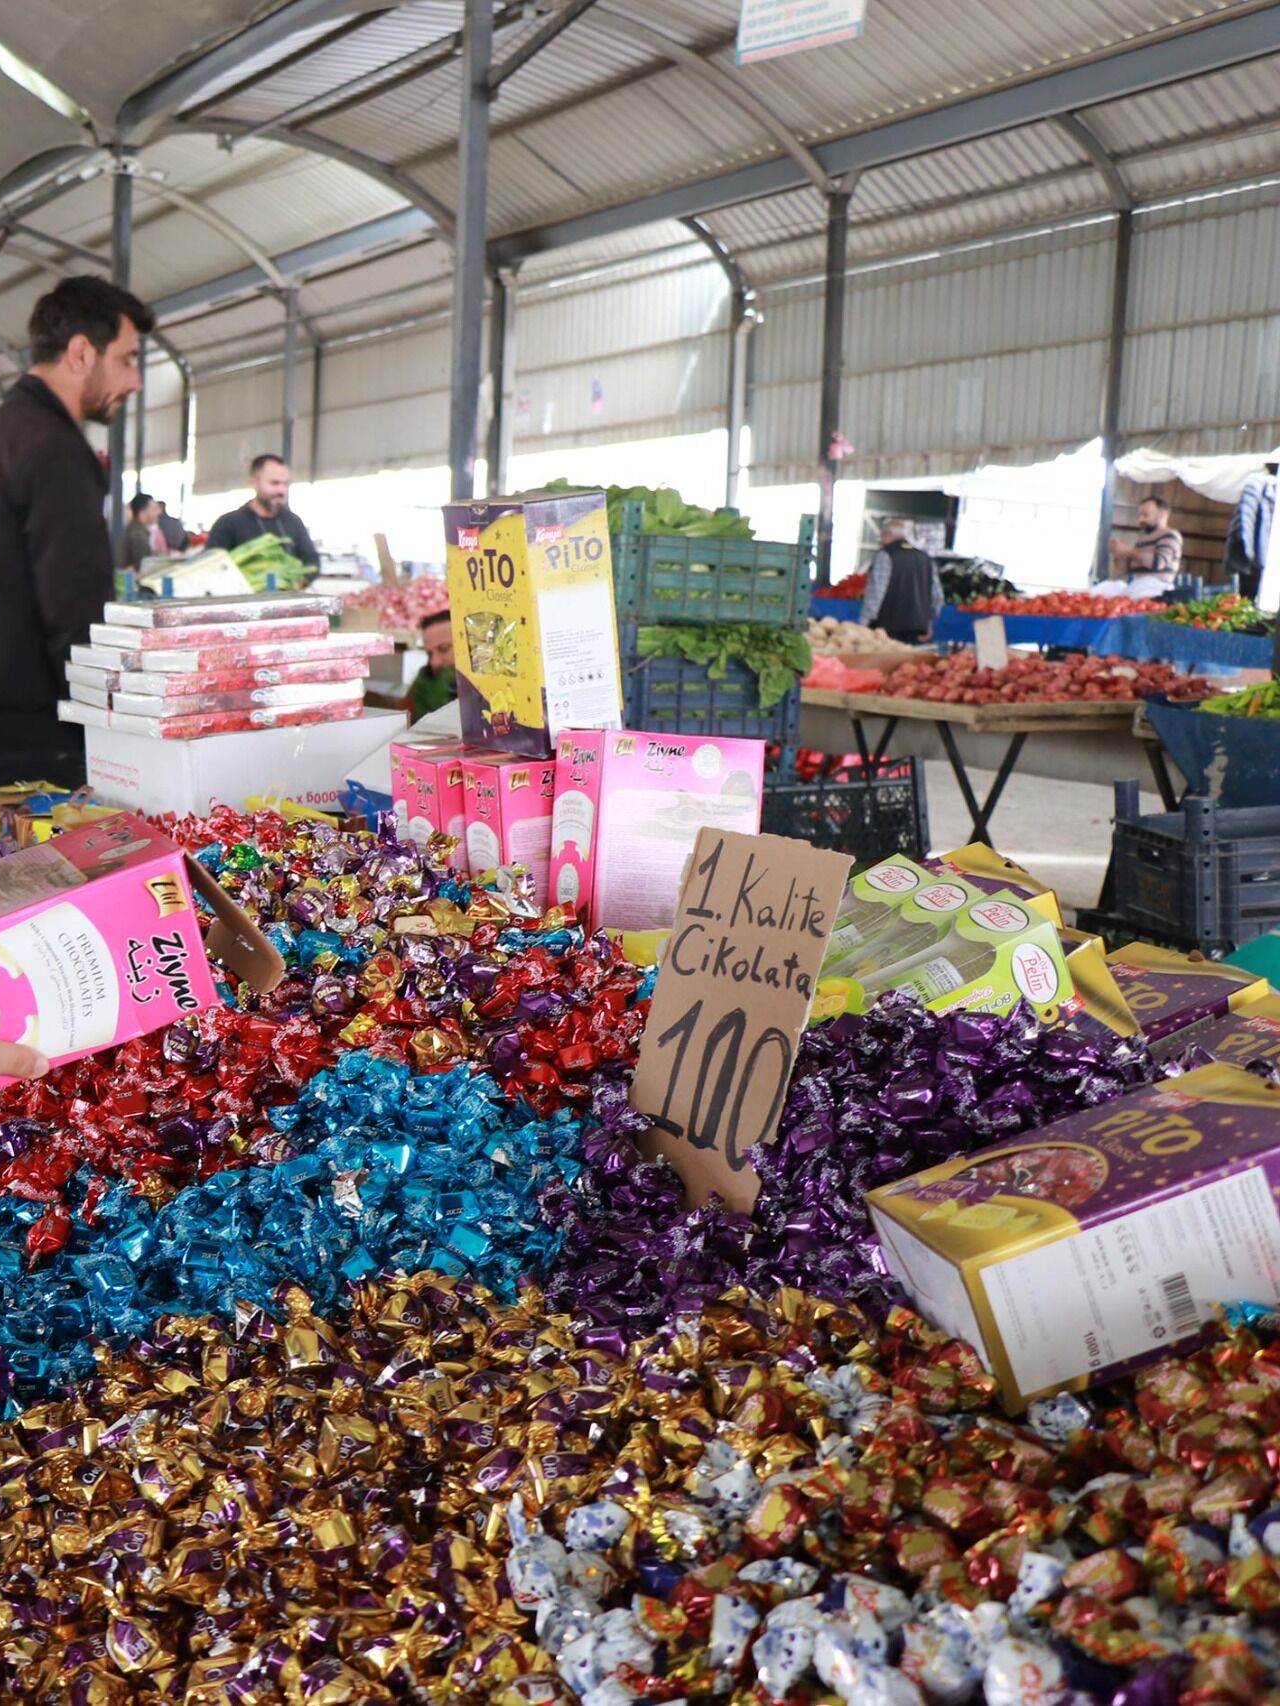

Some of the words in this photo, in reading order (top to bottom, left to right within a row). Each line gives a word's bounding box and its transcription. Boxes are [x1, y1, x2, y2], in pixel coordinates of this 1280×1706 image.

[546, 536, 603, 570] PiTO
[466, 549, 515, 592] PiTO
[573, 748, 597, 767] Ziyne
[648, 742, 686, 759] Ziyne
[306, 790, 342, 804] 000g
[686, 838, 723, 922] 1.
[729, 852, 827, 939] Kalite
[879, 870, 903, 889] Pelin
[930, 888, 951, 906] Pelin
[985, 906, 1011, 928] Pelin
[57, 931, 93, 1018] CHOCOLATES
[76, 932, 106, 1000] PREMIUM
[152, 931, 199, 1012] Ziyne
[1024, 958, 1044, 992] Pelin
[1121, 981, 1169, 1010] TO
[643, 999, 792, 1173] 100
[1088, 1109, 1204, 1156] PiTO
[1083, 1331, 1101, 1357] 1000
[475, 1424, 495, 1447] CHO
[542, 1455, 561, 1478] CHO
